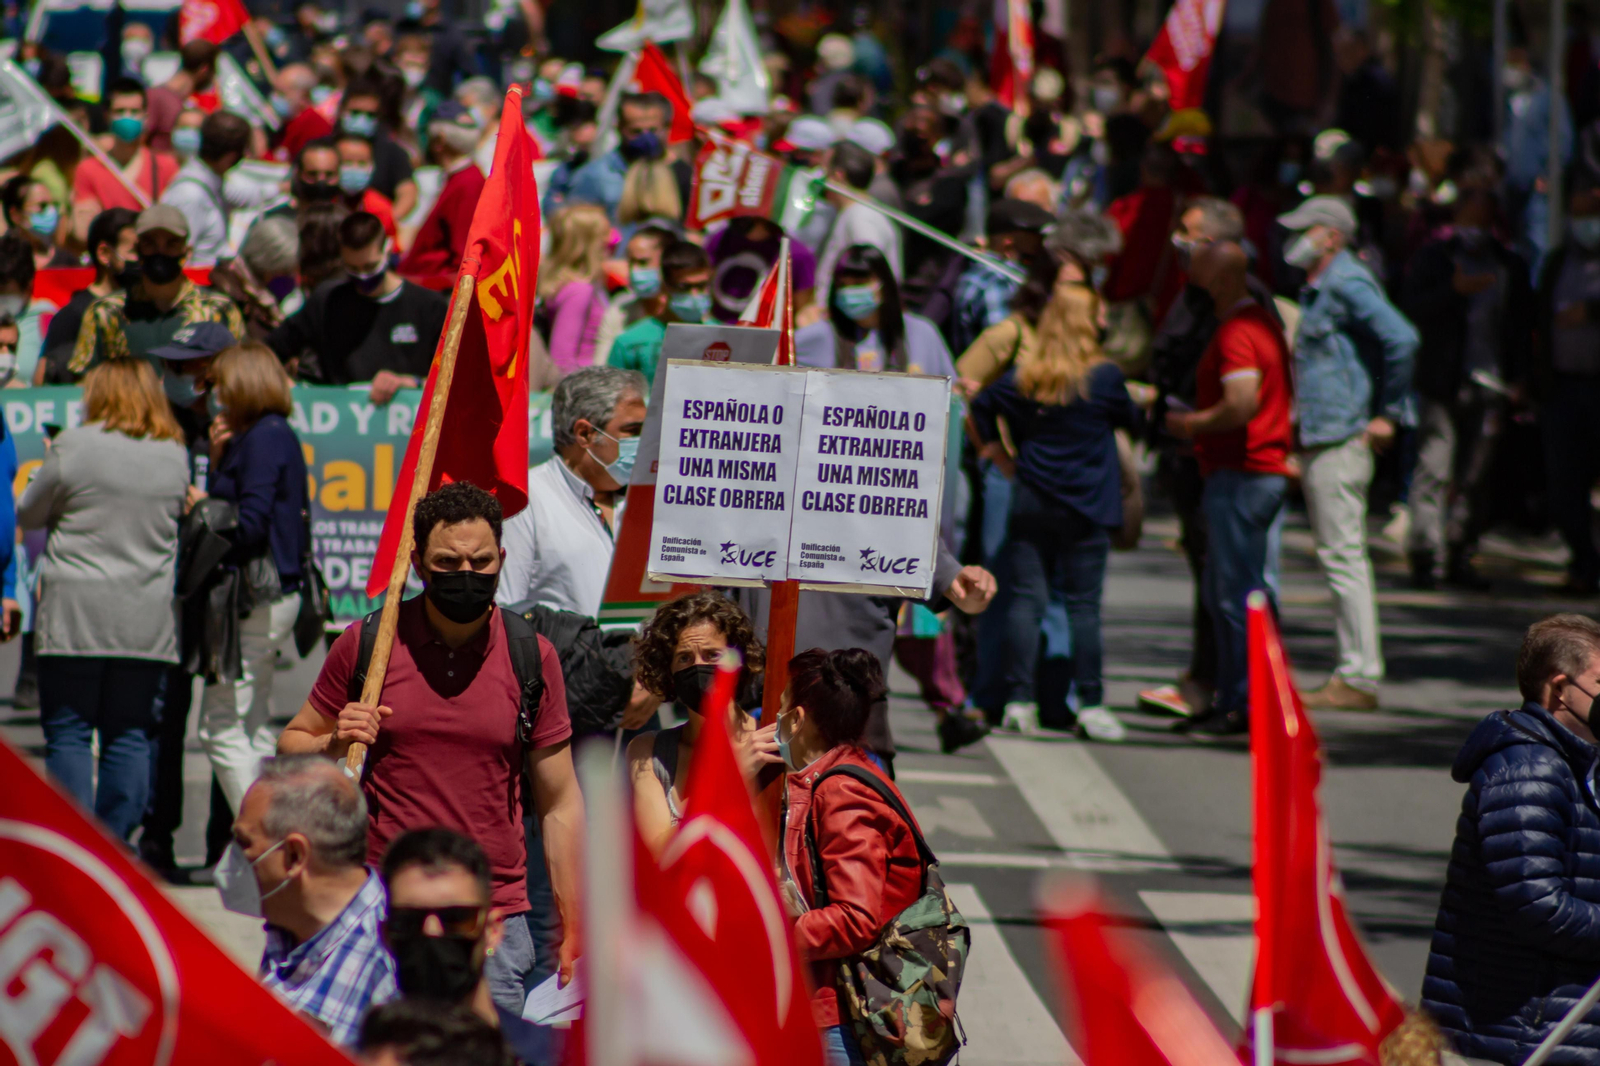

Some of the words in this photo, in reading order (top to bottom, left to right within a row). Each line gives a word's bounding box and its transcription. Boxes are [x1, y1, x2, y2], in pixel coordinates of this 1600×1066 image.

[703, 349, 730, 361] STOP
[6, 402, 54, 434] DE
[350, 402, 375, 435] Y
[683, 398, 769, 425] ESPAÑOLA
[772, 405, 784, 425] O
[822, 405, 910, 431] ESPAÑOLA
[914, 412, 926, 432] O
[679, 428, 782, 453] EXTRANJERA
[818, 434, 924, 461] EXTRANJERA
[679, 456, 713, 478] UNA
[717, 459, 777, 482] MISMA
[818, 463, 853, 485] UNA
[857, 466, 919, 489] MISMA
[663, 484, 717, 507] CLASE
[720, 488, 785, 511] OBRERA
[802, 490, 856, 513] CLASE
[859, 494, 928, 519] OBRERA
[312, 521, 337, 535] OS
[661, 545, 699, 555] Comunista
[662, 536, 702, 546] Unificación
[801, 542, 841, 553] Unificación
[660, 553, 685, 562] España
[739, 549, 777, 568] UCE
[799, 560, 825, 569] España
[800, 551, 838, 561] Comunista
[879, 556, 920, 575] UCE
